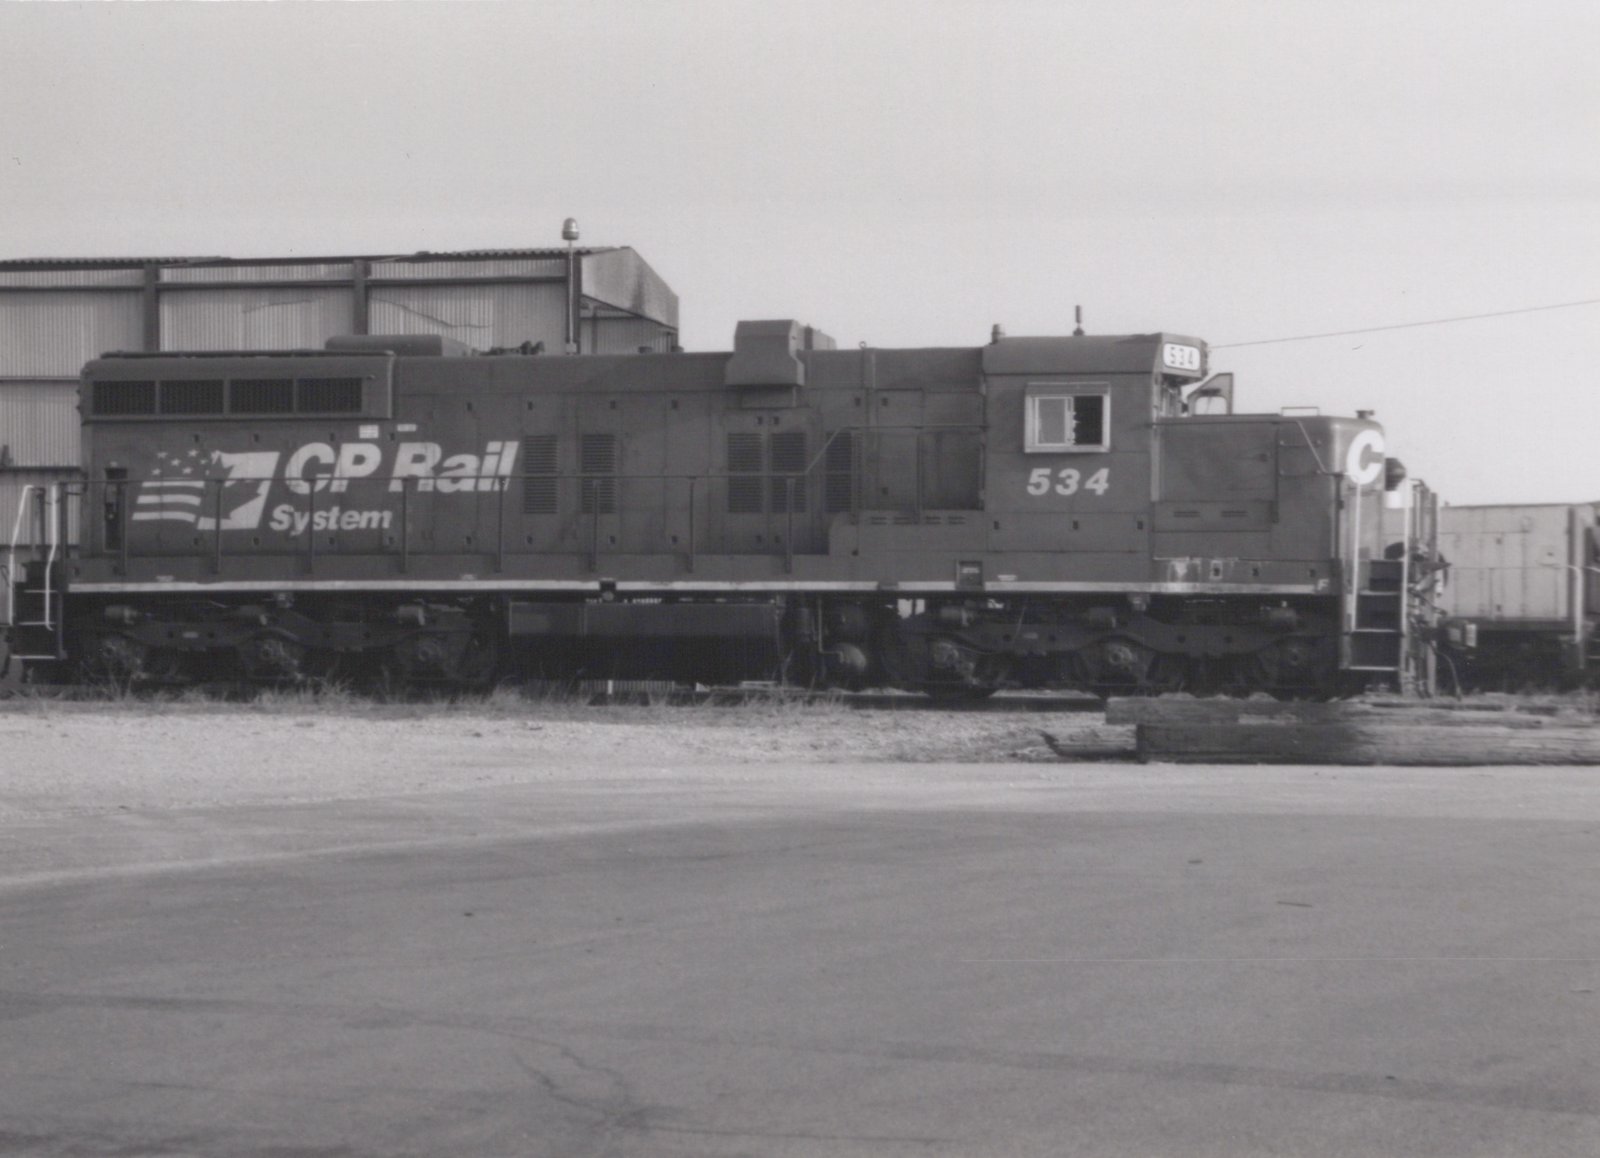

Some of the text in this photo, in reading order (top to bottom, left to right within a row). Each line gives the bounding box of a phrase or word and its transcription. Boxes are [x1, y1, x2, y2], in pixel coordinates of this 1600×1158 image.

[1169, 345, 1195, 367] 534
[284, 441, 519, 494] CP Rail
[1346, 429, 1385, 485] C
[1026, 468, 1110, 495] 534
[269, 504, 392, 536] System
